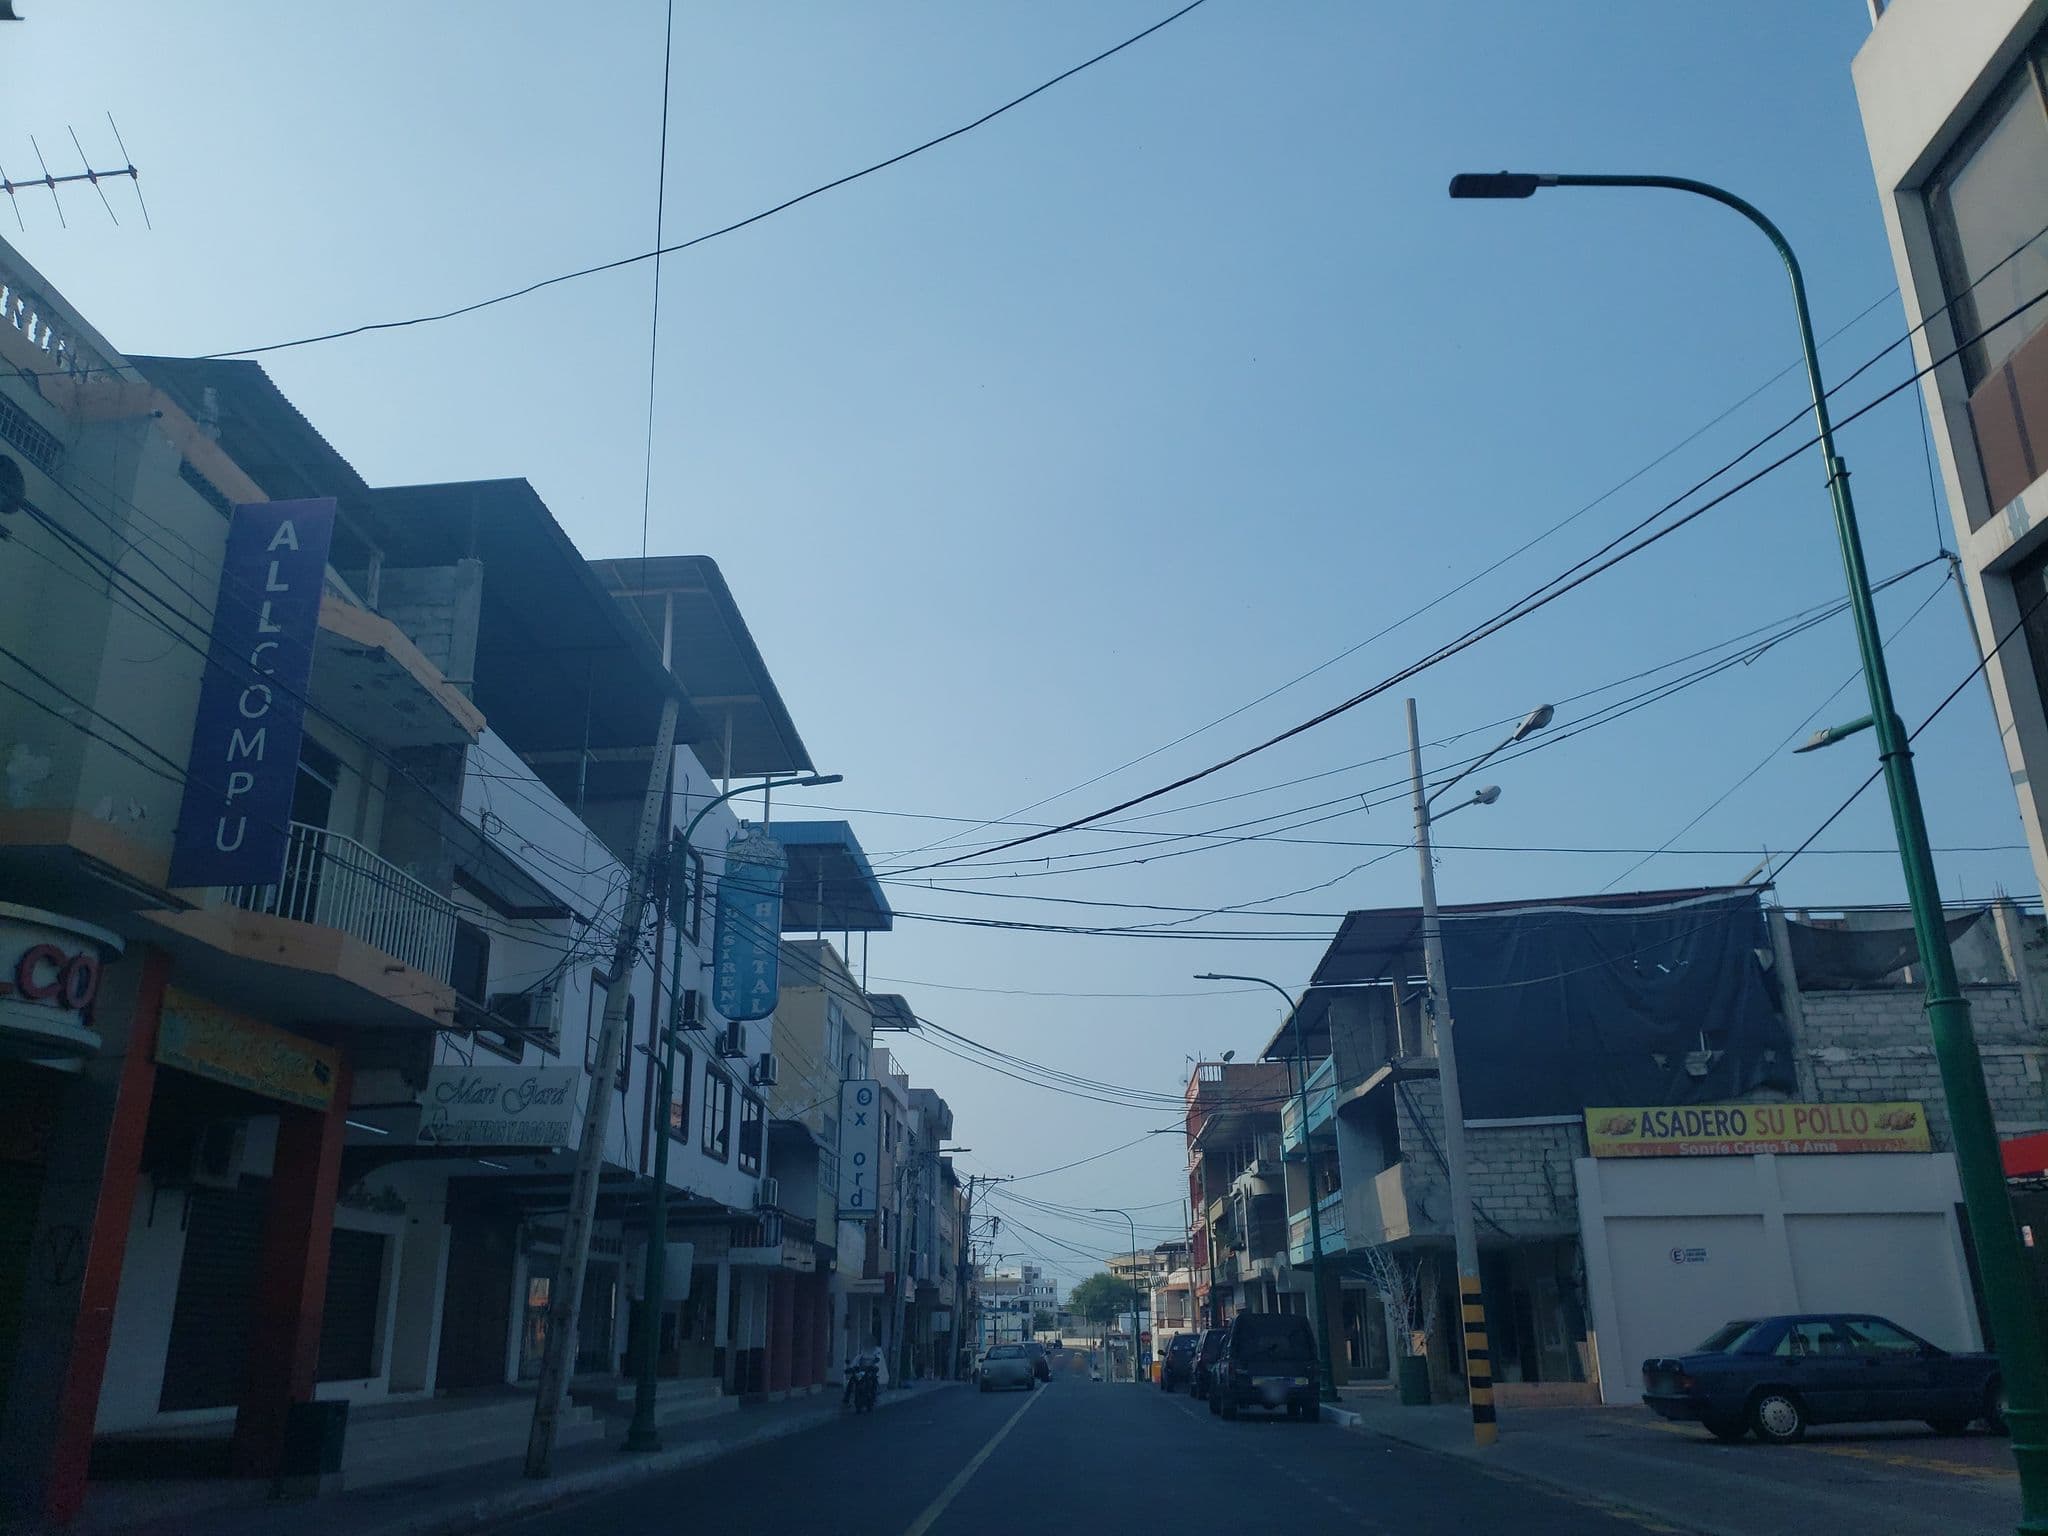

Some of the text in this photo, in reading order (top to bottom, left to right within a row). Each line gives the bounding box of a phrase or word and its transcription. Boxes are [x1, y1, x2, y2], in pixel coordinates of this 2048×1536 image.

[216, 520, 299, 851] ALLCOMPU
[0, 944, 98, 1009] CO
[436, 1077, 501, 1104] Mari
[1641, 1107, 1868, 1137] ASADERO SU POLLO
[850, 1087, 873, 1207] Oxord
[1734, 1141, 1777, 1154] Cristo
[1781, 1139, 1800, 1153] Te
